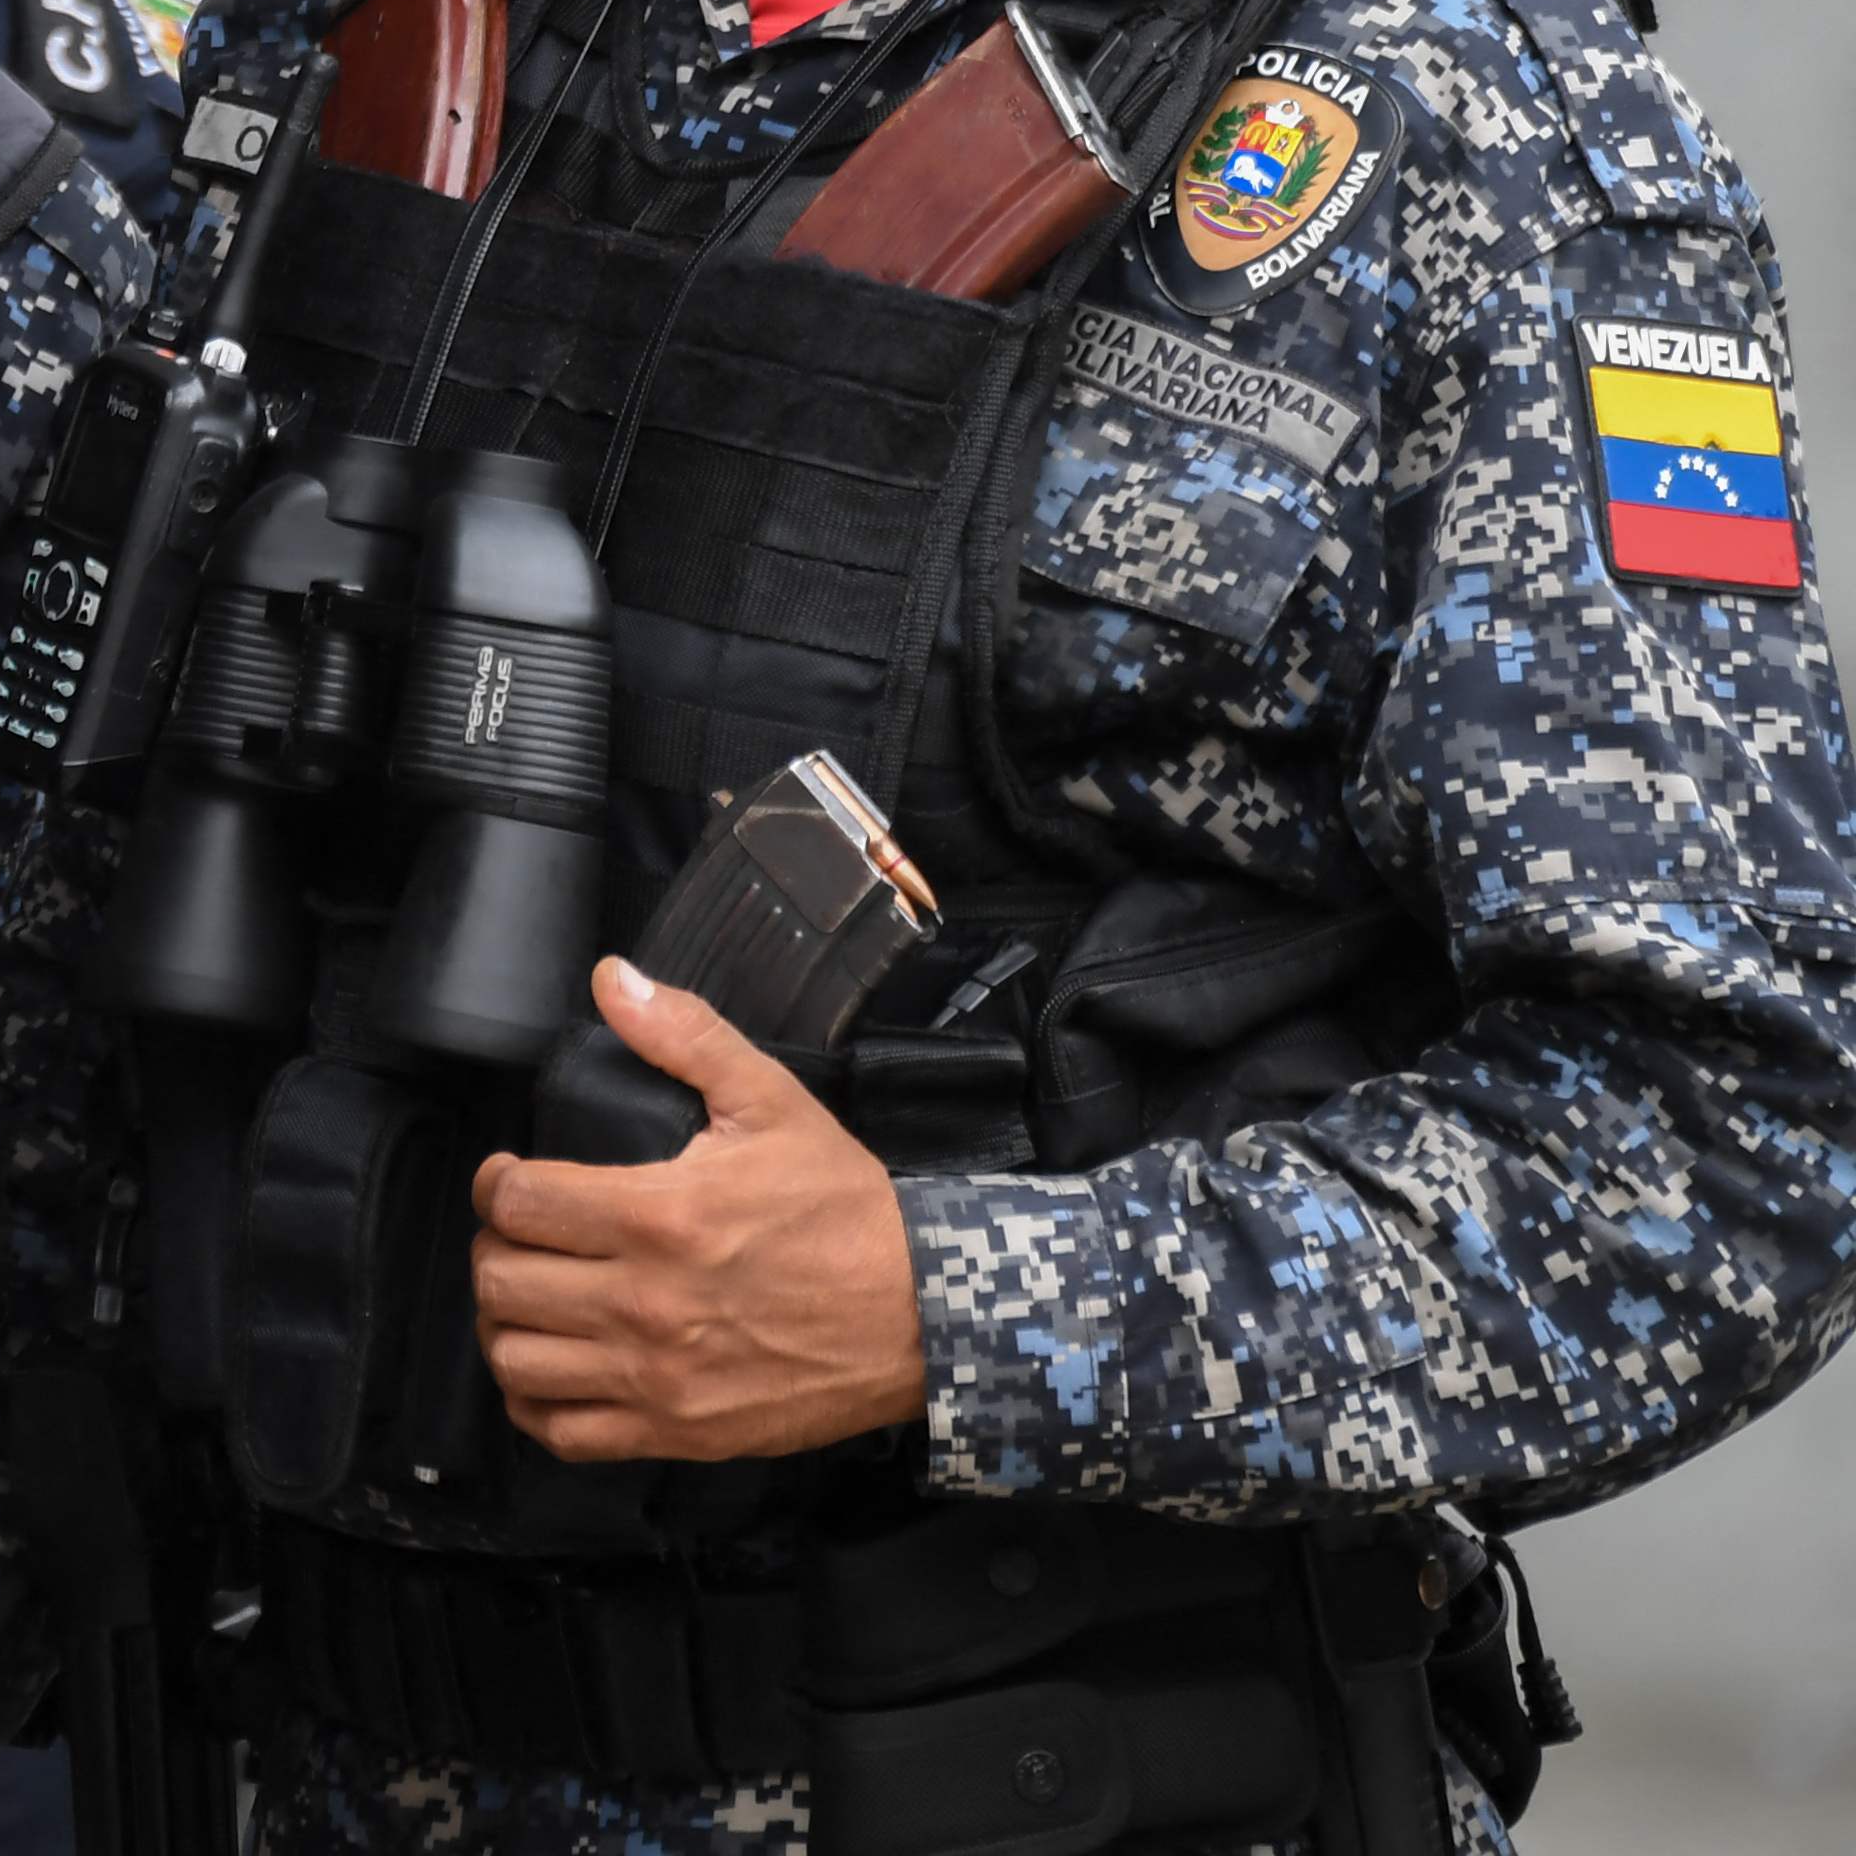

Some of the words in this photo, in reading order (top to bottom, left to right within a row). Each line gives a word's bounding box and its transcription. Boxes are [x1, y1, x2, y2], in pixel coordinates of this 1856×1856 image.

[1245, 150, 1381, 290] BOLIVARIANA
[1147, 336, 1336, 437] NACIONAL
[1581, 322, 1772, 383] VENEZUELA
[465, 646, 494, 744] PERMA
[486, 658, 512, 742] FOCUS
